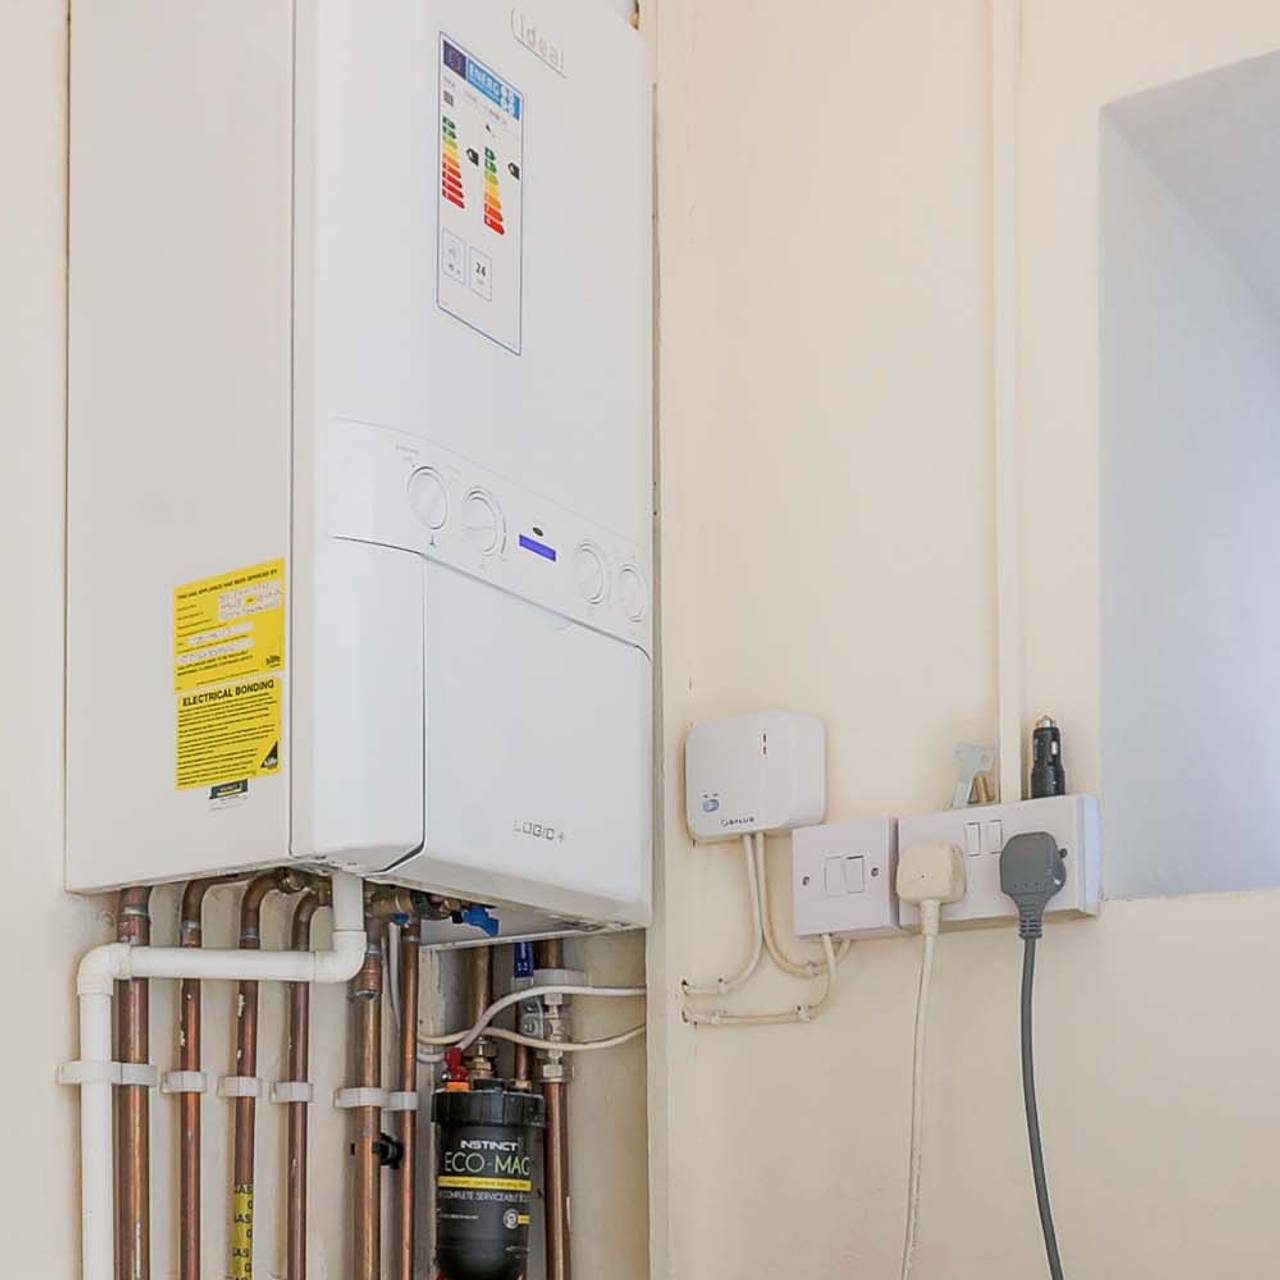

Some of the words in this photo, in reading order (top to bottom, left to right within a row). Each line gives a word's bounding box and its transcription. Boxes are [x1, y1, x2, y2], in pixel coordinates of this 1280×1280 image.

[183, 688, 233, 707] ELECTRICAL
[235, 679, 274, 696] BONDING
[460, 1139, 518, 1151] INSTINCT
